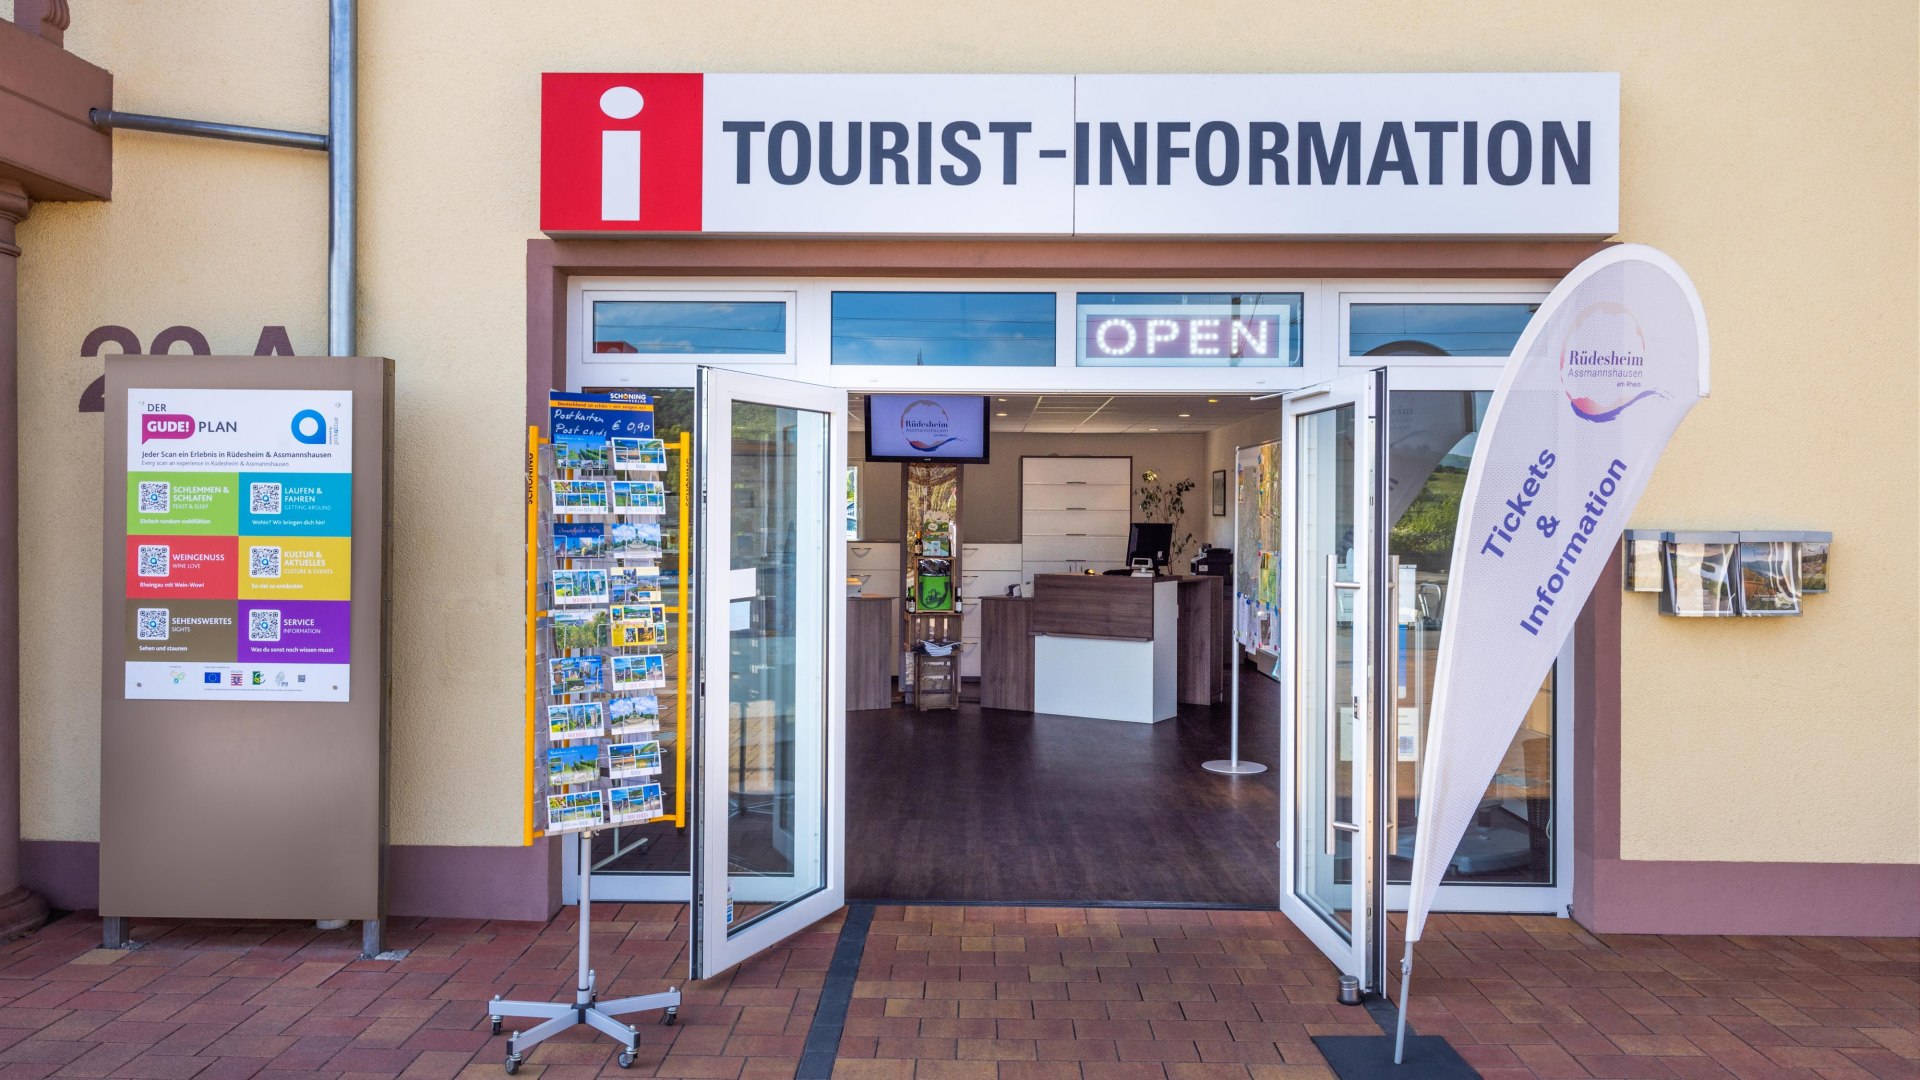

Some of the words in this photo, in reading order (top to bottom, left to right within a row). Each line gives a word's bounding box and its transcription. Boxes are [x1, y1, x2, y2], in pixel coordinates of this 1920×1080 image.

[723, 119, 1591, 187] TOURIST-INFORMATION
[1096, 318, 1268, 355] OPEN
[1569, 350, 1644, 366] Rüdesheim
[1568, 368, 1643, 378] Assmannshausen
[147, 403, 167, 412] DER
[146, 420, 190, 433] GUDE!
[198, 421, 238, 433] PLAN
[626, 422, 650, 434] 0,90
[905, 420, 948, 428] Rüdesheim
[141, 450, 159, 459] Jeder
[226, 450, 264, 458] Rüdesheim
[222, 486, 230, 494] &
[172, 494, 213, 502] SCHLAFEN
[284, 495, 316, 503] FAHREN
[1480, 449, 1557, 559] Tickets
[283, 519, 303, 527] bringen
[1536, 514, 1561, 539] &
[1520, 458, 1628, 636] Information
[172, 553, 225, 561] WEINGENUSS
[284, 551, 314, 559] KULTUR
[284, 559, 326, 567] AKTUELLES
[140, 581, 164, 589] Rheingau
[172, 617, 232, 625] SEHENSWERTES
[284, 618, 315, 626] SERVICE
